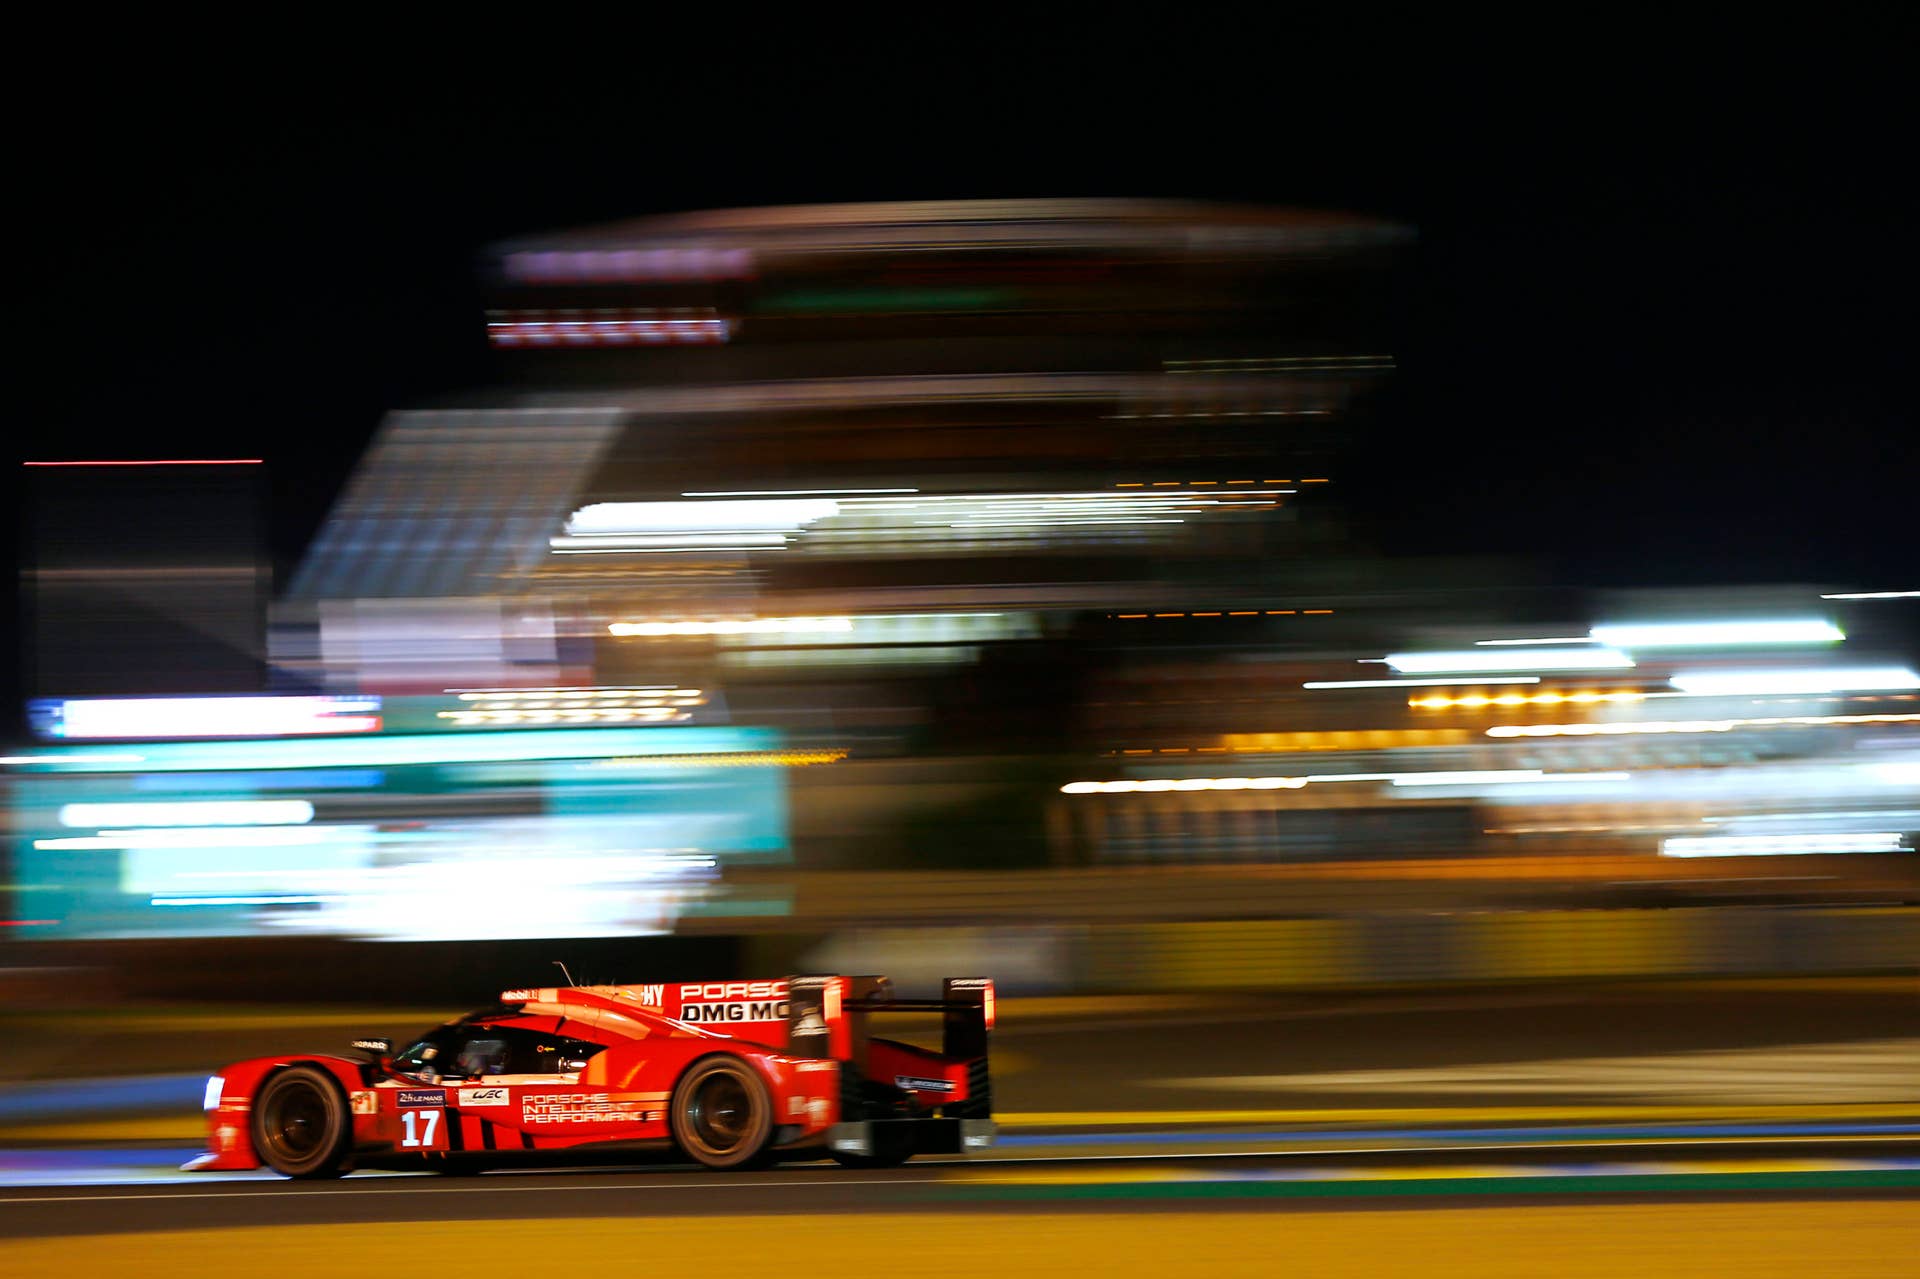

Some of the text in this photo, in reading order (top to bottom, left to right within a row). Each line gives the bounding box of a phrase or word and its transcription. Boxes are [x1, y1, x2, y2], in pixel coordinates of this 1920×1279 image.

[681, 1003, 743, 1022] DMG
[472, 1089, 503, 1099] WEC
[522, 1093, 609, 1105] PORSCHE
[523, 1111, 663, 1124] PERFORMANCE
[401, 1110, 440, 1147] 17
